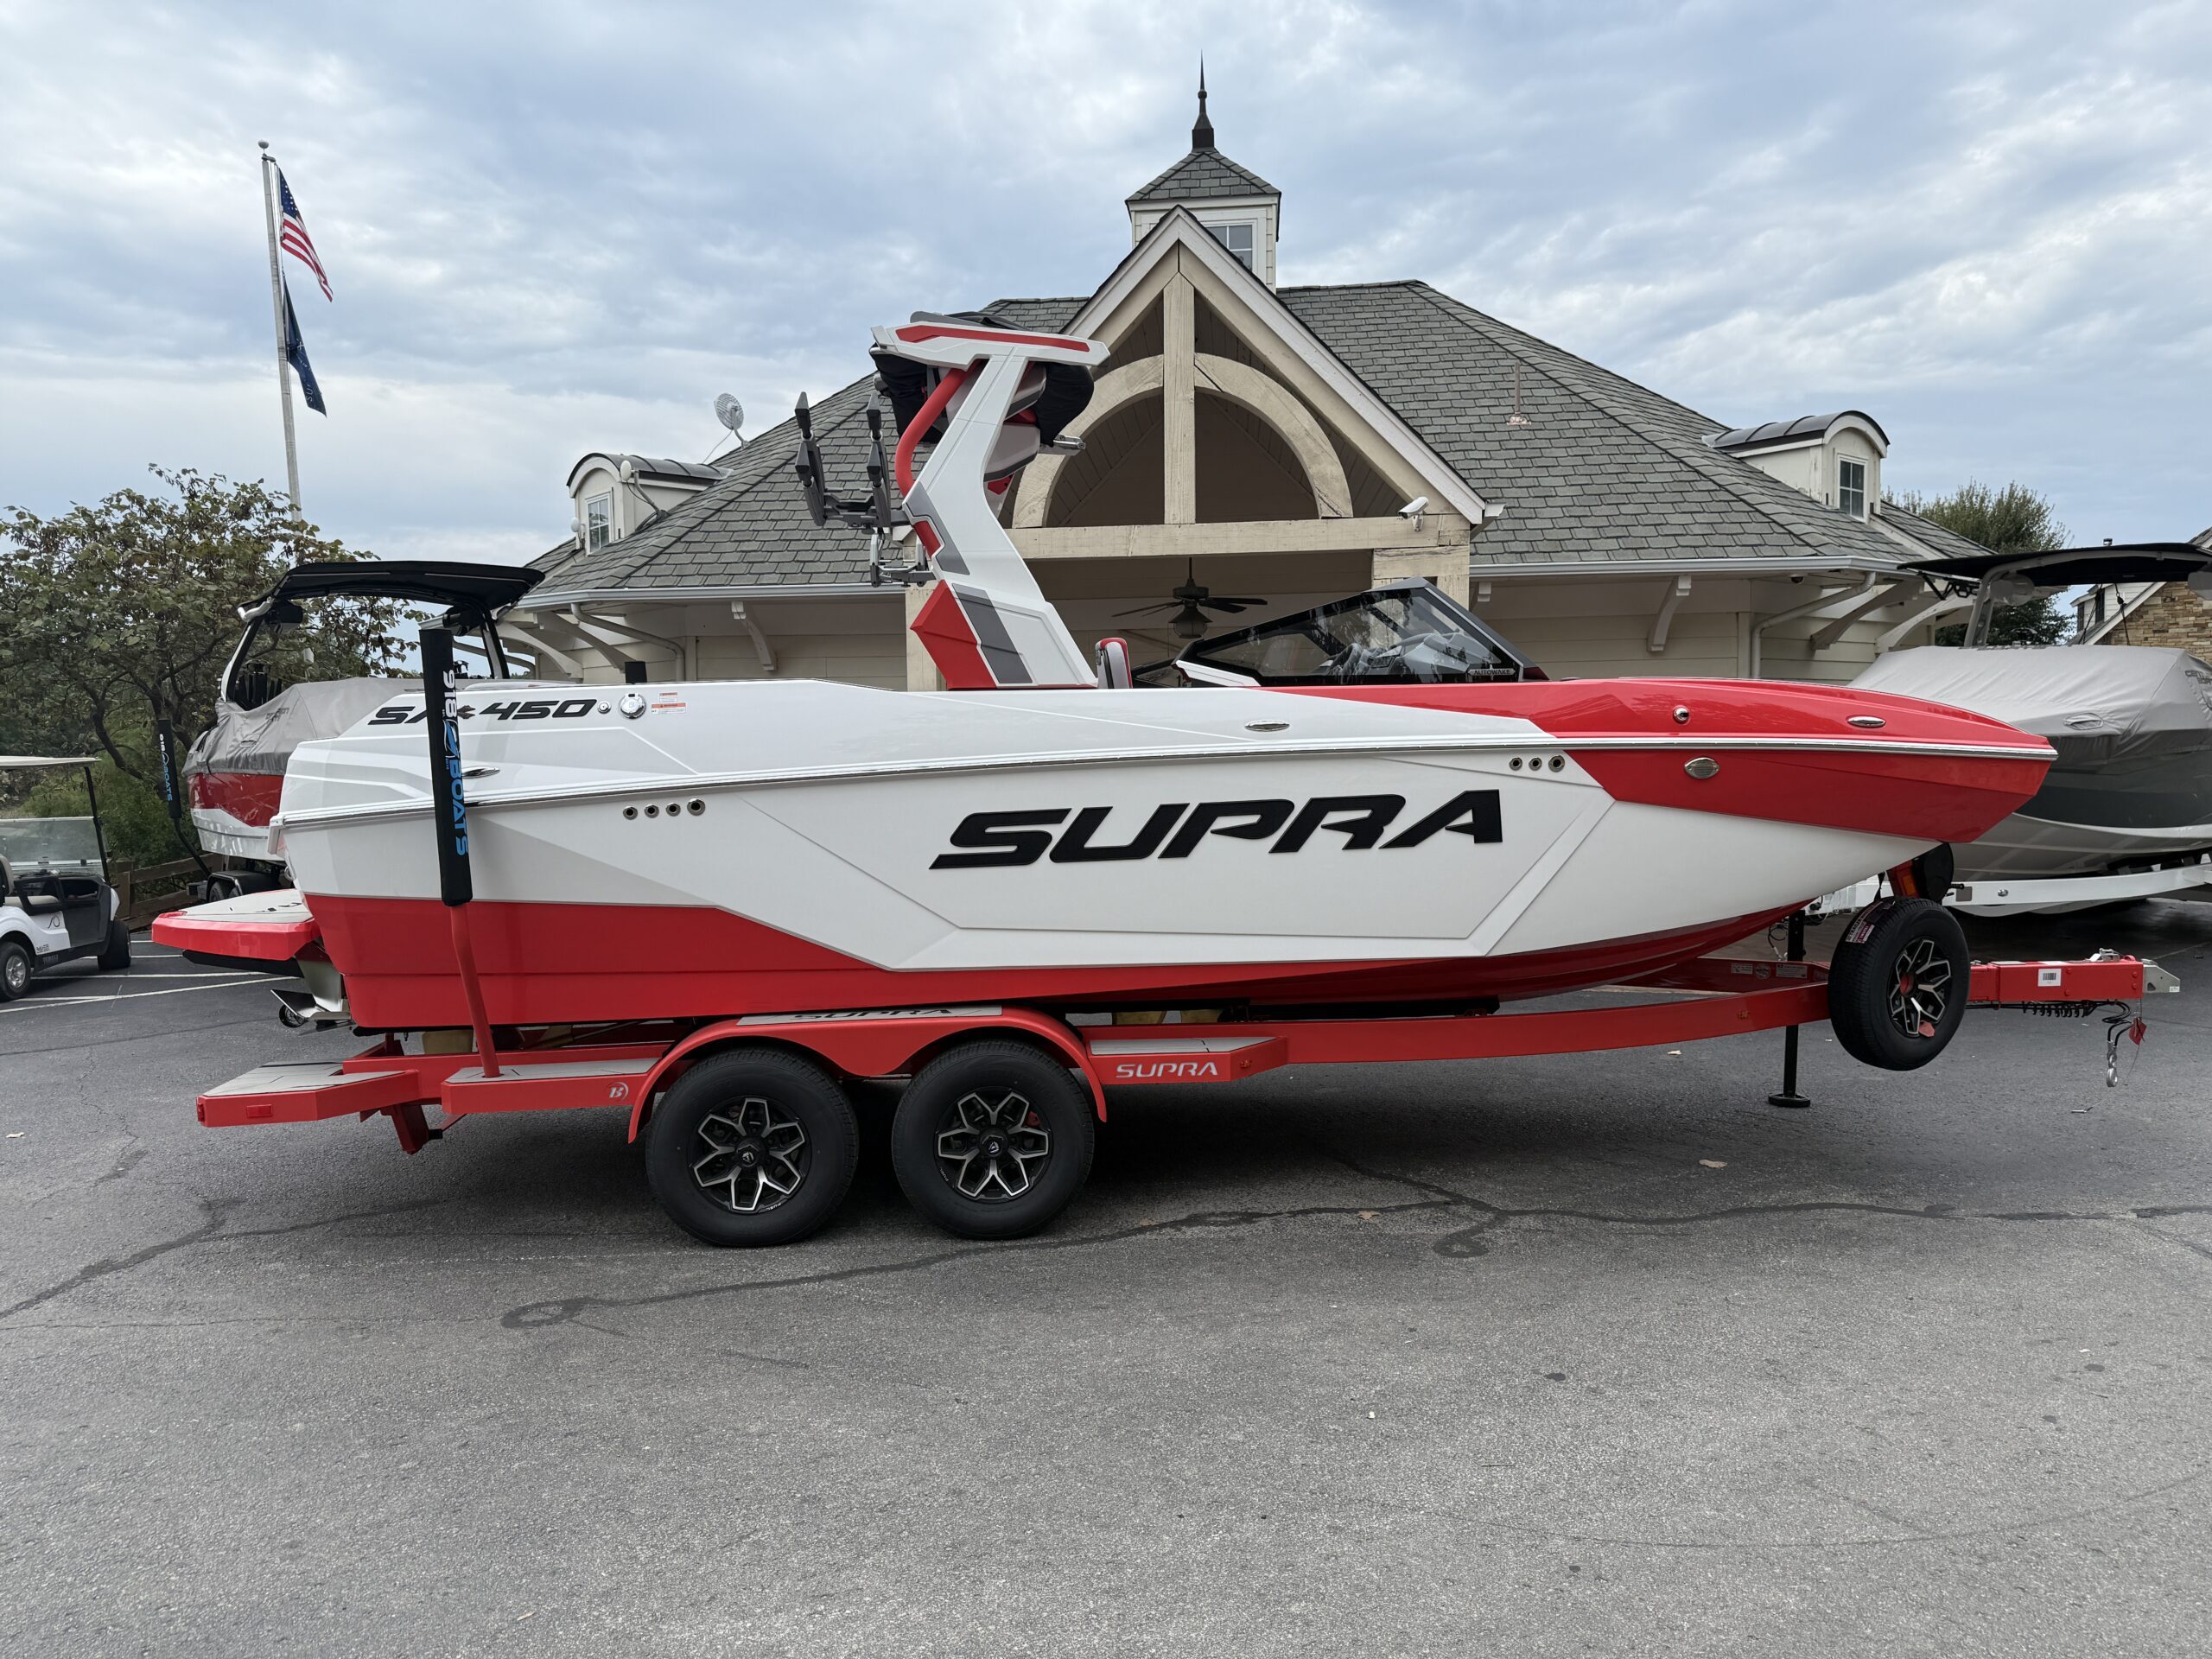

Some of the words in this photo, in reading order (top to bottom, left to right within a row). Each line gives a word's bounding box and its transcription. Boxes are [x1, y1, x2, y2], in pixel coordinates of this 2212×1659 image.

[480, 699, 597, 720] 450
[443, 670, 457, 718] 918
[450, 760, 468, 856] BOATS
[929, 789, 1503, 869] SUPRA
[791, 1009, 951, 1020] SUPRA
[1116, 1062, 1218, 1078] SUPRA
